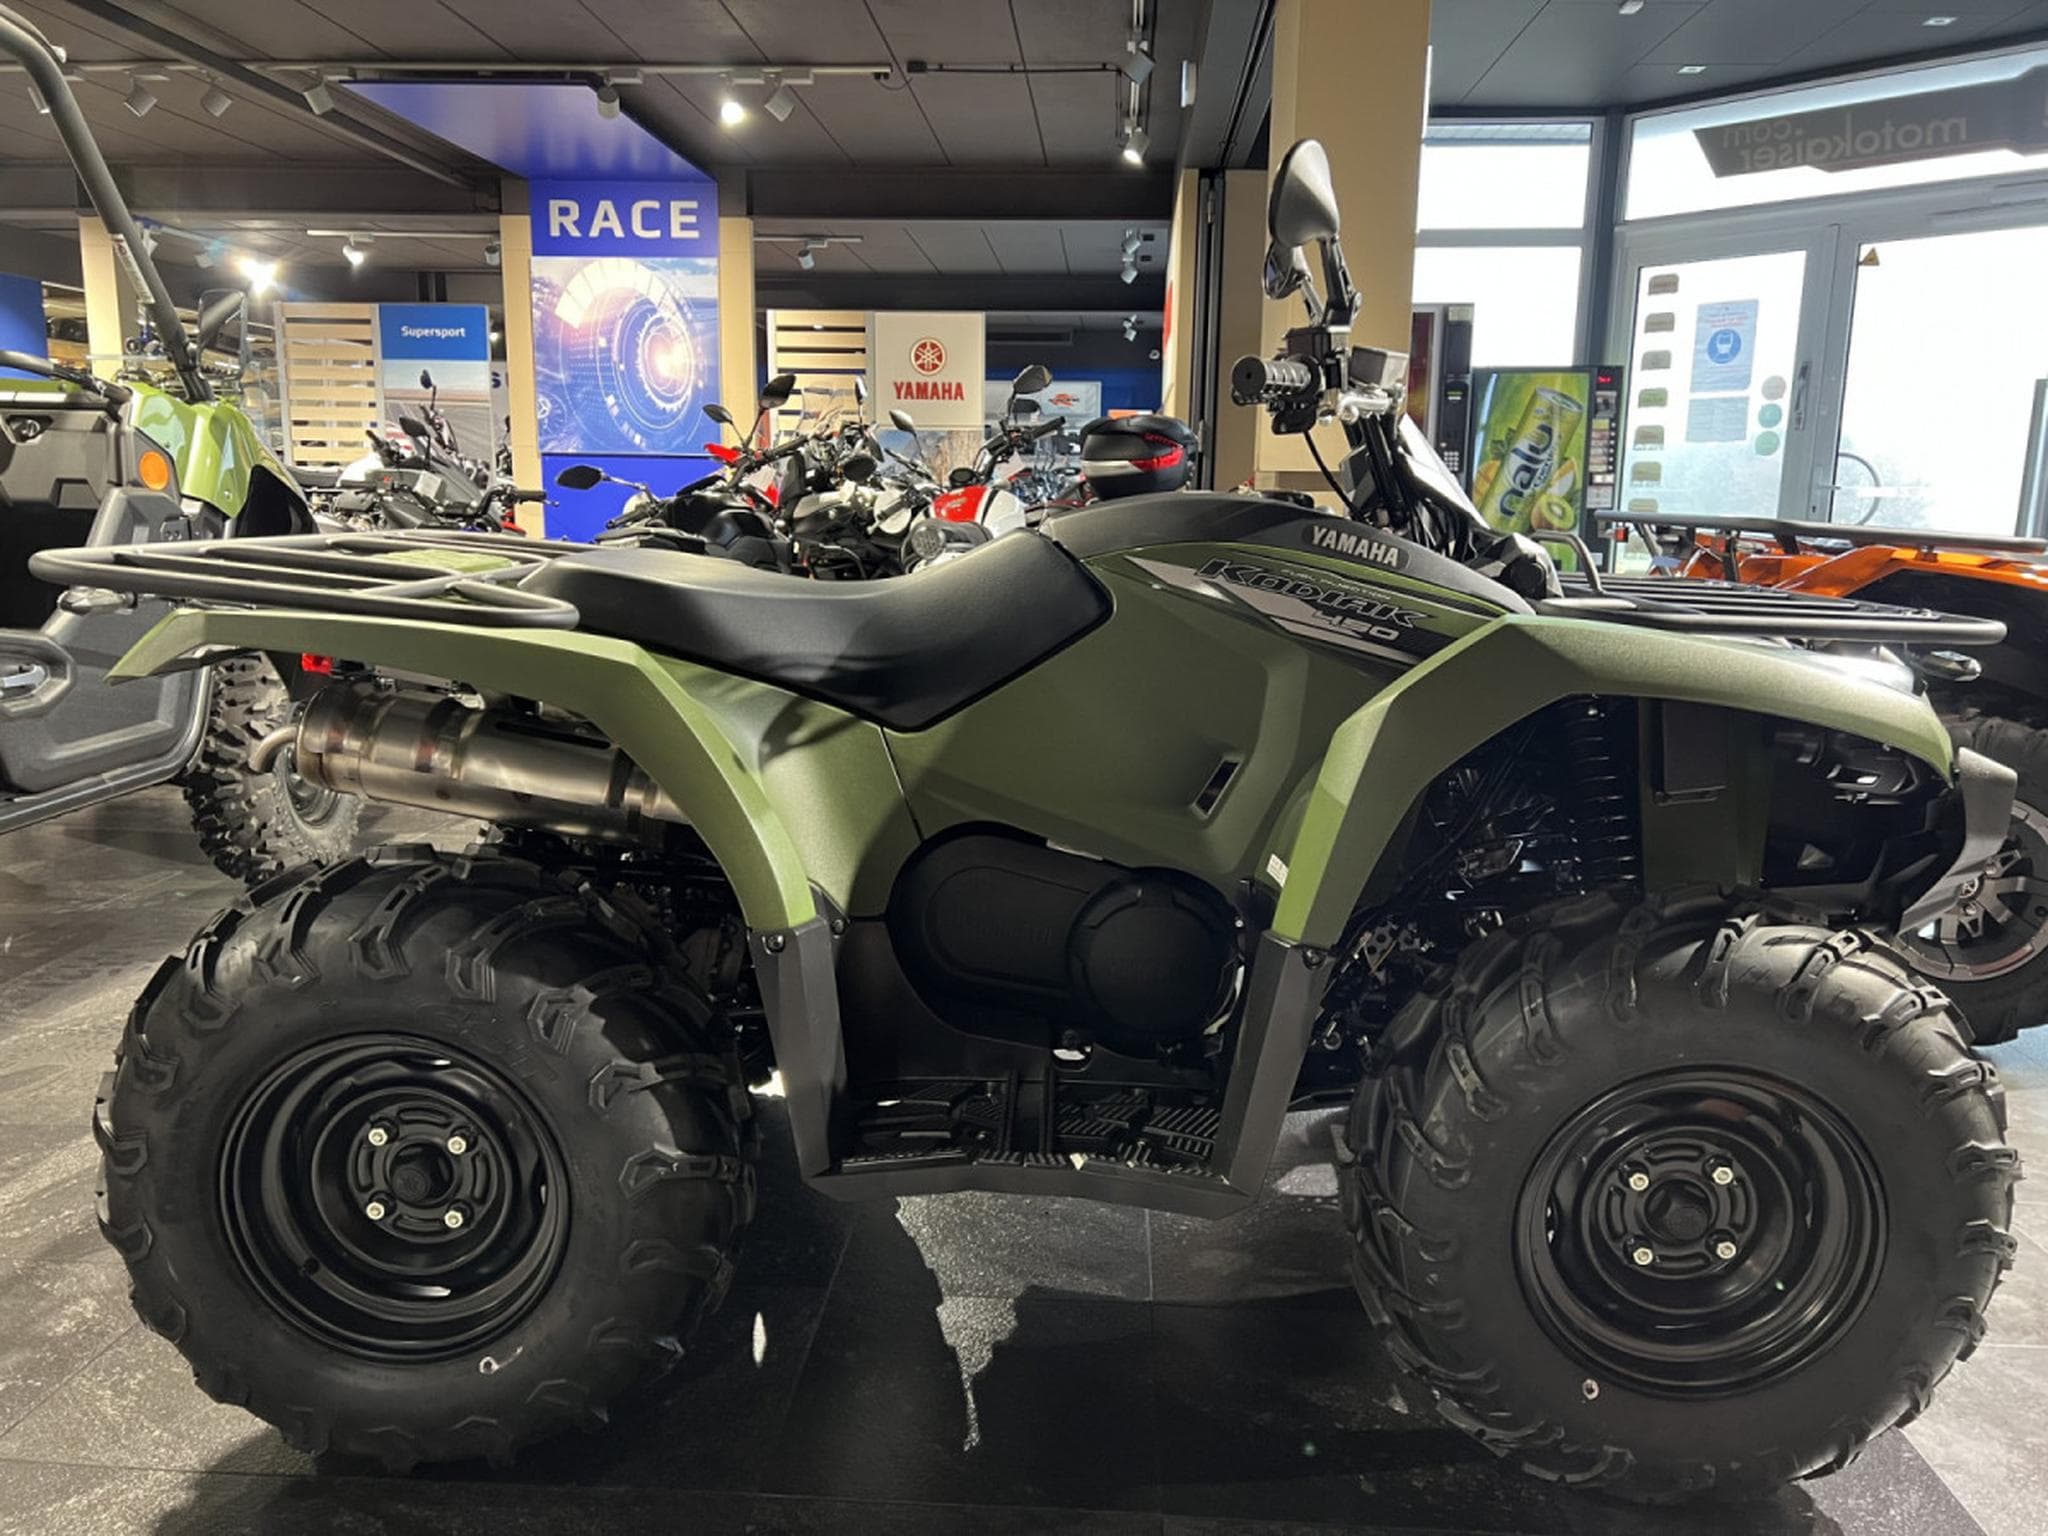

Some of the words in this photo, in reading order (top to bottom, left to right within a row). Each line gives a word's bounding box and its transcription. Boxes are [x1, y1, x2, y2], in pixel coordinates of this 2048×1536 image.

[548, 199, 700, 239] RACE
[400, 325, 467, 339] Supersport
[893, 381, 966, 401] YAMAHA
[1499, 422, 1554, 518] nalu
[1311, 525, 1400, 568] YAMAHA
[1311, 608, 1401, 642] 450
